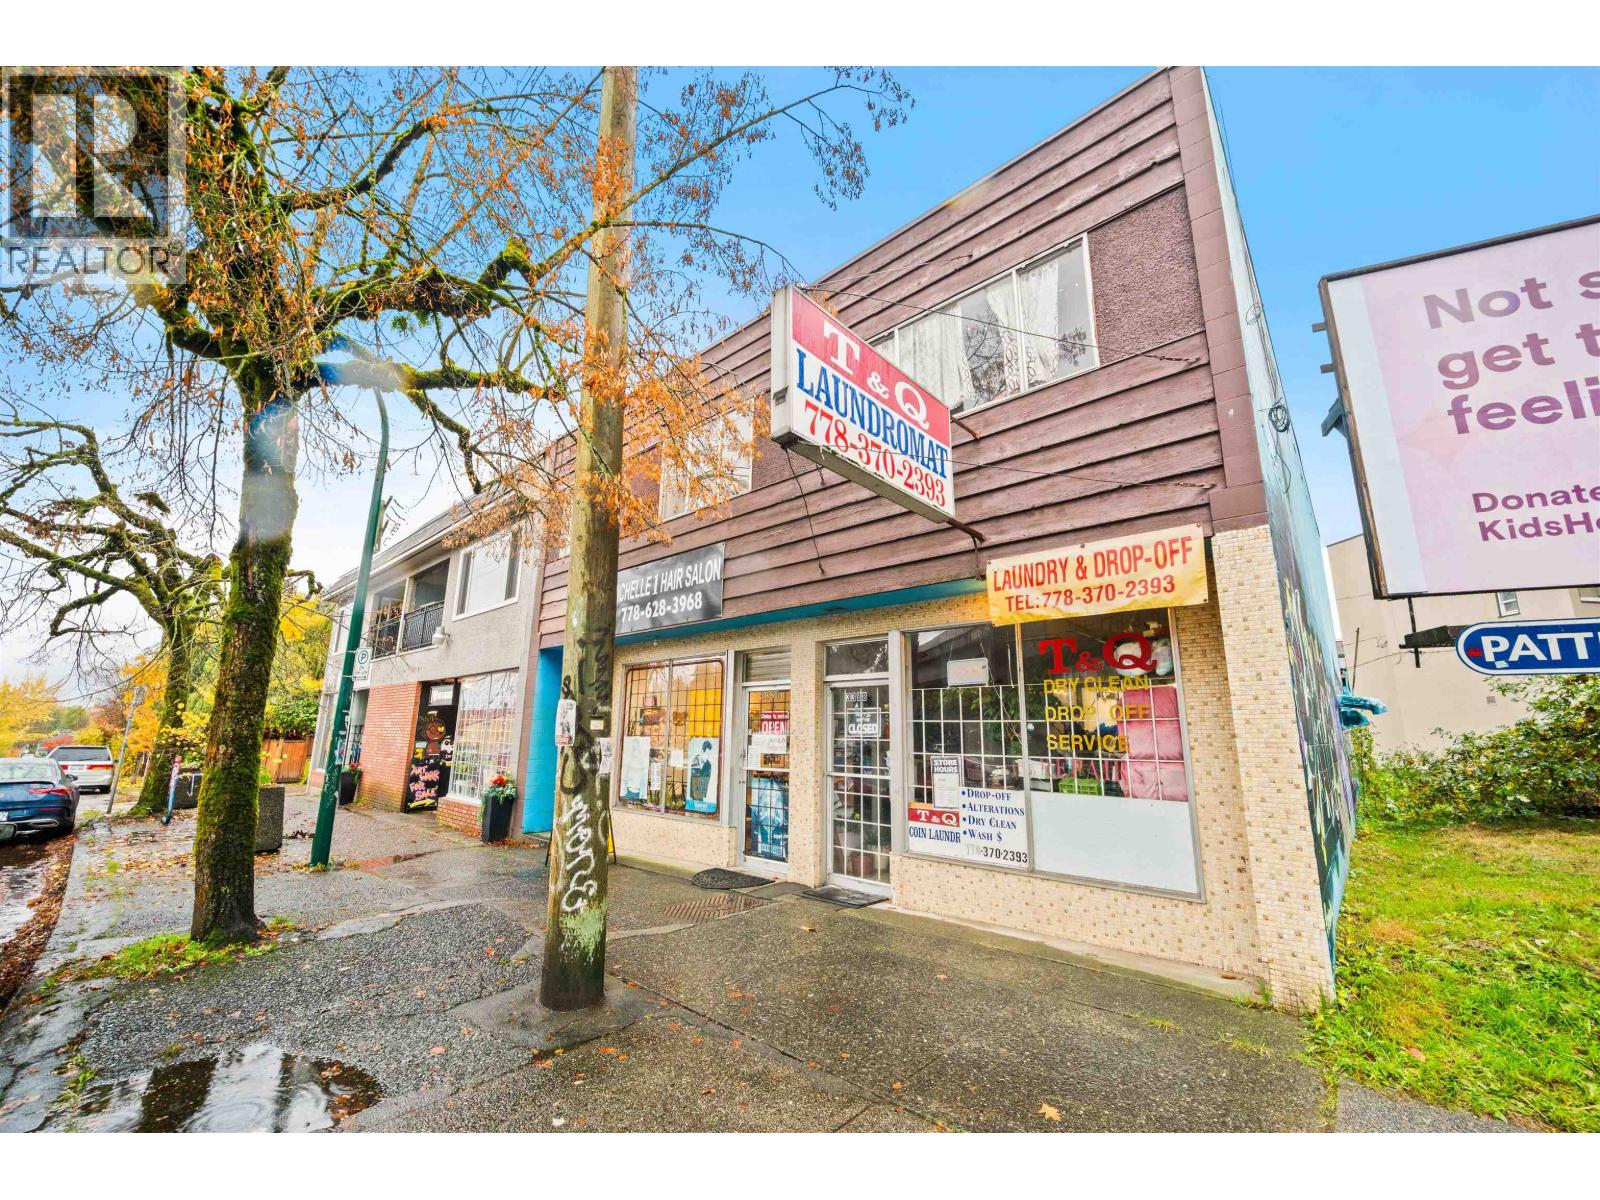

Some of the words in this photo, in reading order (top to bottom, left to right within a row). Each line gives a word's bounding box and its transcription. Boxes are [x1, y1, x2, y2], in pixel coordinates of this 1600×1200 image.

[1423, 277, 1554, 330] Not
[823, 320, 861, 375] T
[866, 371, 889, 400] &
[894, 381, 929, 430] Q
[1437, 333, 1556, 390] get
[796, 348, 948, 479] LAUNDROMAT
[804, 400, 946, 507] 778-370-2393
[1479, 512, 1600, 541] KidsH
[660, 567, 684, 593] HAIR
[685, 557, 721, 588] SALON
[993, 557, 1069, 592] LAUNDRY
[1075, 555, 1088, 581] &
[1093, 536, 1193, 578] DROP-OFF
[621, 591, 703, 623] 778-628-3968
[1039, 638, 1077, 674] T
[1074, 651, 1104, 672] &
[1103, 631, 1157, 671] Q
[1481, 632, 1600, 662] PATT
[1043, 678, 1080, 695] DRY
[1083, 673, 1151, 693] CLEAN
[1044, 704, 1097, 722] DROP
[1109, 704, 1152, 721] OFF
[848, 723, 879, 735] CLOSED
[1046, 733, 1131, 753] SERVICE
[933, 759, 958, 767] STORE
[933, 766, 959, 774] HOURS
[909, 826, 927, 840] COIN
[917, 810, 930, 822] T
[931, 815, 940, 823] &
[941, 812, 958, 826] Q
